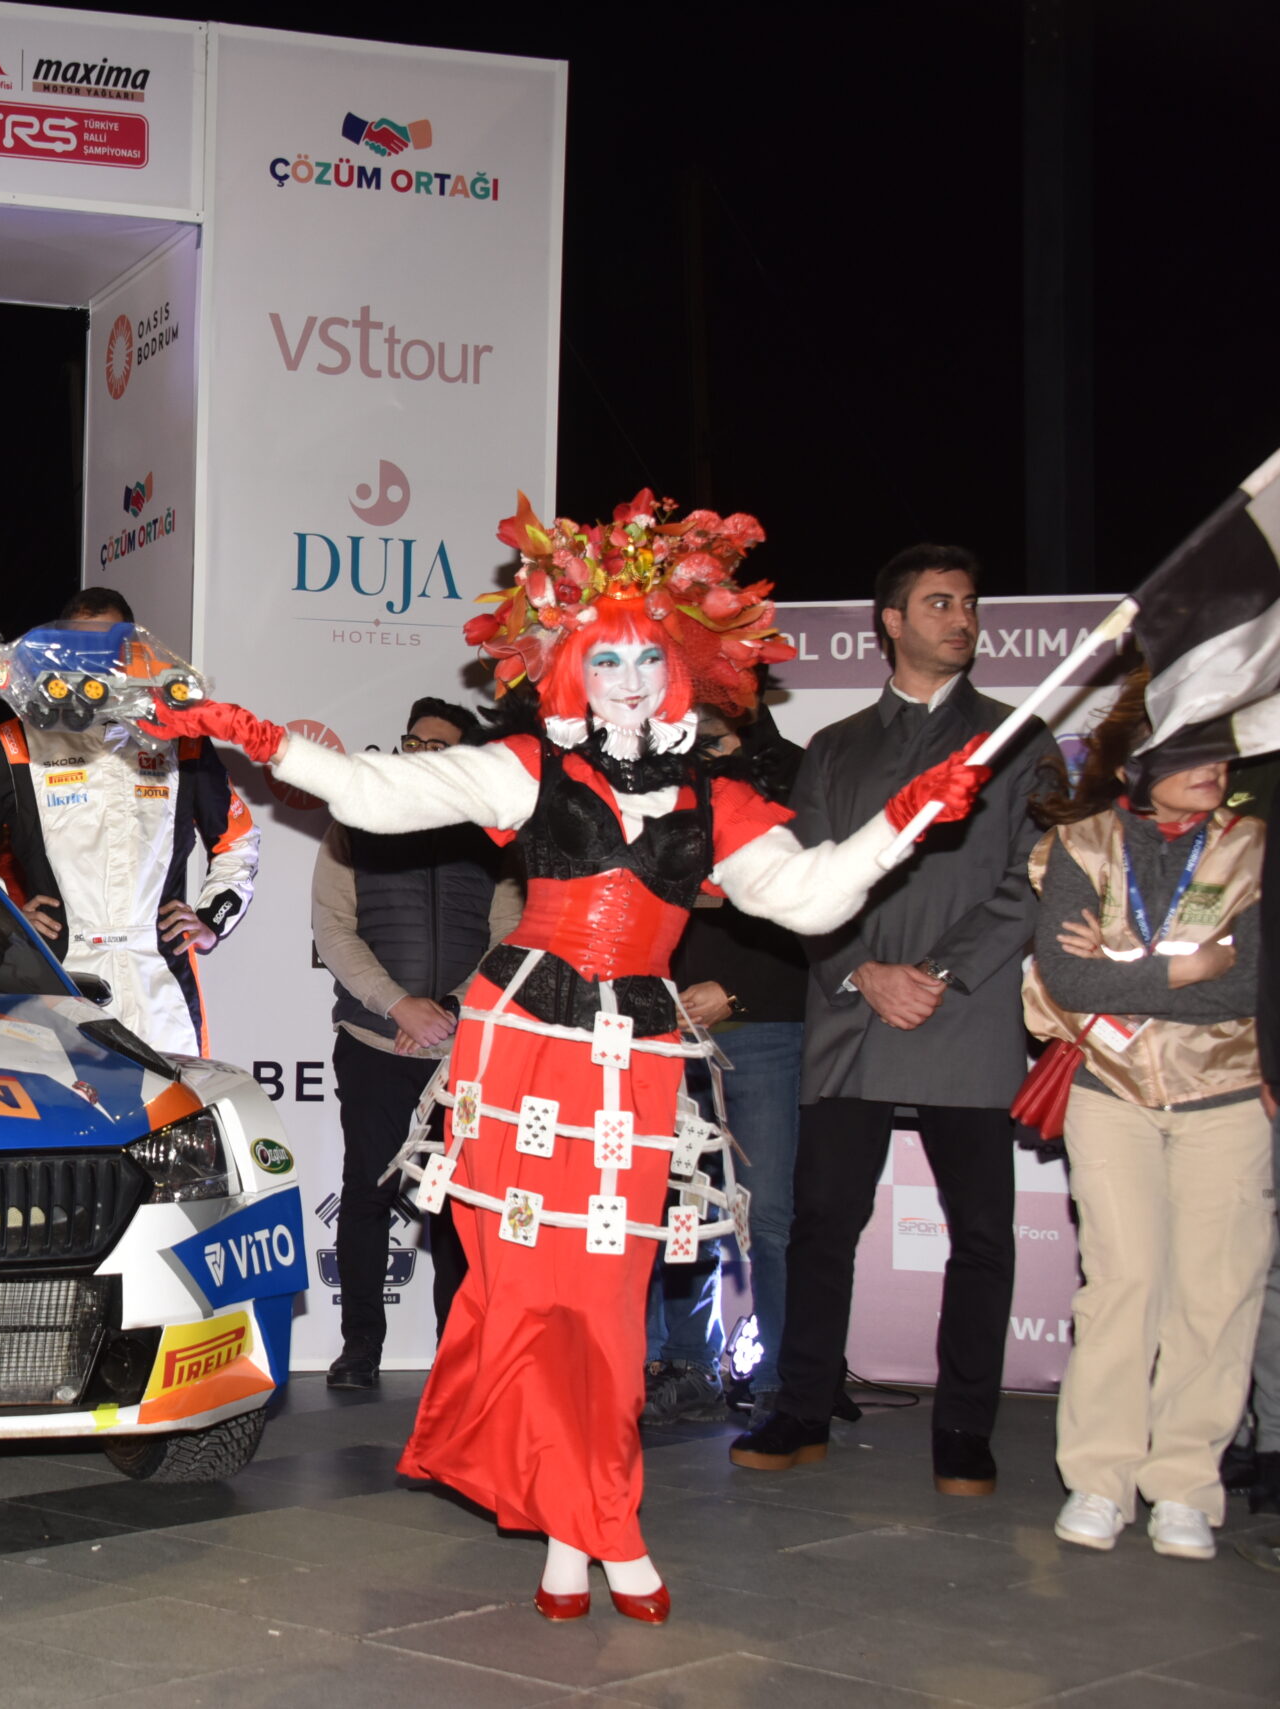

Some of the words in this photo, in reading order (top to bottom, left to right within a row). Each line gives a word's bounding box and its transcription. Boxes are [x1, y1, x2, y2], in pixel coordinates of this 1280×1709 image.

[32, 57, 151, 91] maxima
[43, 83, 81, 96] MOTOR
[86, 86, 135, 101] YAĞLARI
[83, 118, 119, 132] TÜRKİYE
[83, 131, 107, 143] RALLİ
[83, 144, 141, 159] ŞAMPİYONASI
[269, 153, 382, 191] ÇÖZÜM
[390, 168, 499, 201] ORTAĞI
[137, 301, 170, 339] OASIS
[137, 321, 179, 366] BODRUM
[100, 528, 136, 571] ÇÖZÜM
[137, 507, 176, 548] ORTAĞI
[291, 532, 463, 615] DUJA
[332, 630, 421, 647] HOTELS
[49, 771, 84, 784] PIRELLI
[162, 1325, 246, 1390] PIRELLI
